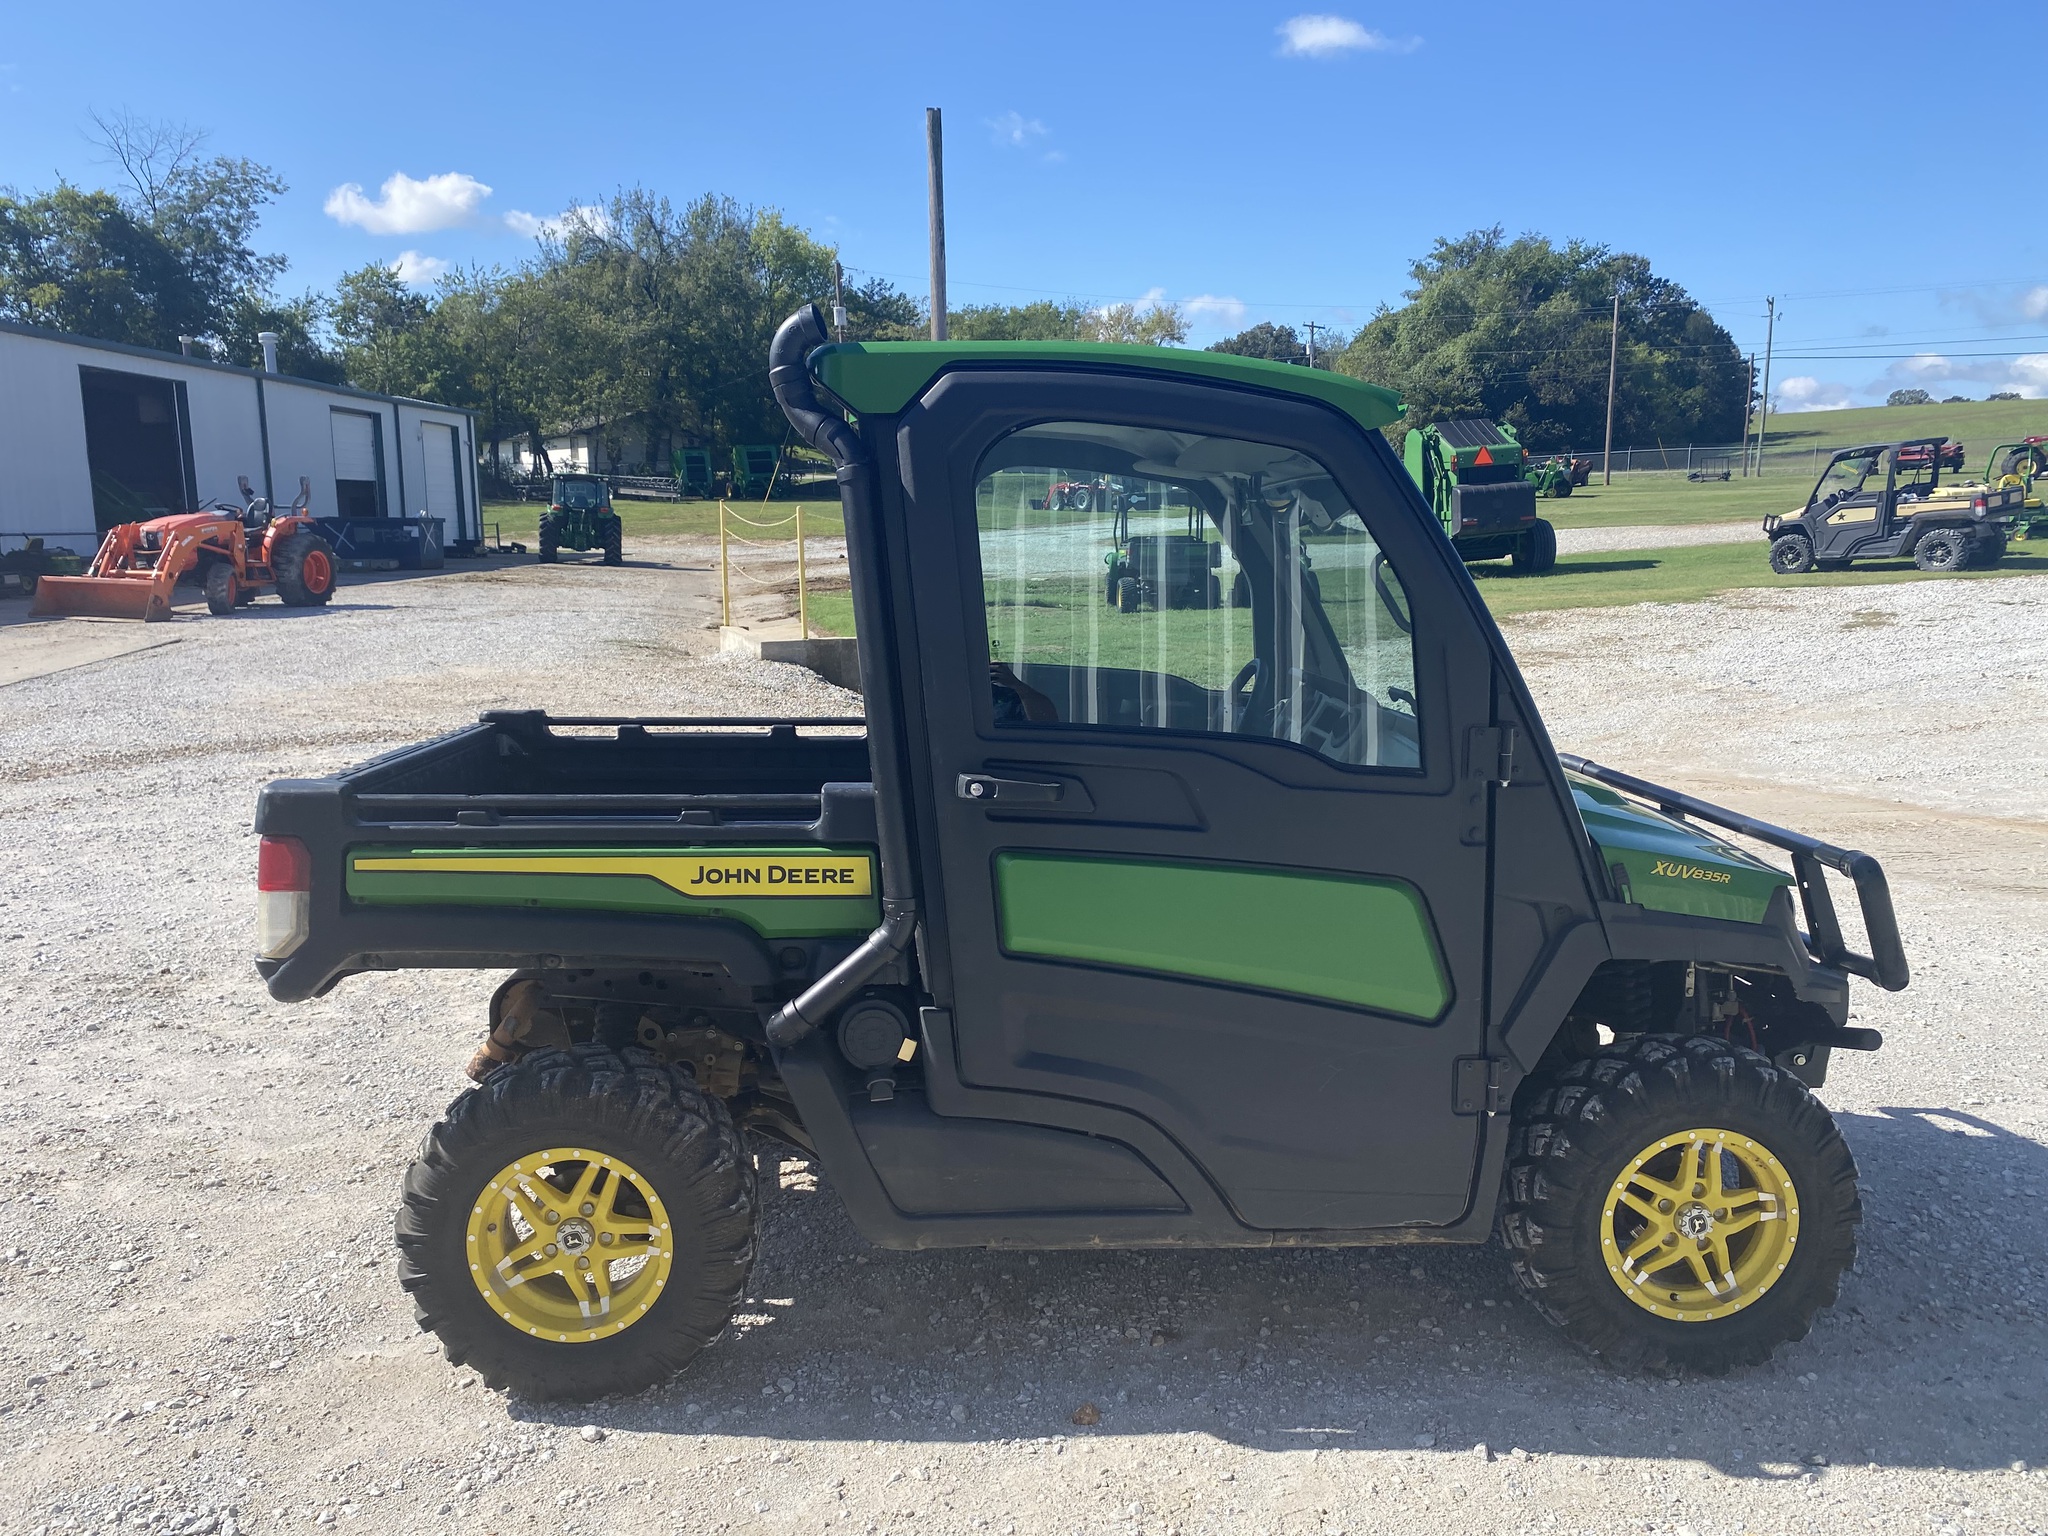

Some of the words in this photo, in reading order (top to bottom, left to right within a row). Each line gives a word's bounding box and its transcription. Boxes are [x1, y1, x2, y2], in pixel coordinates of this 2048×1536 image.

[690, 865, 761, 884] JOHN
[768, 865, 855, 884] DEERE
[1650, 860, 1732, 884] XUV835R
